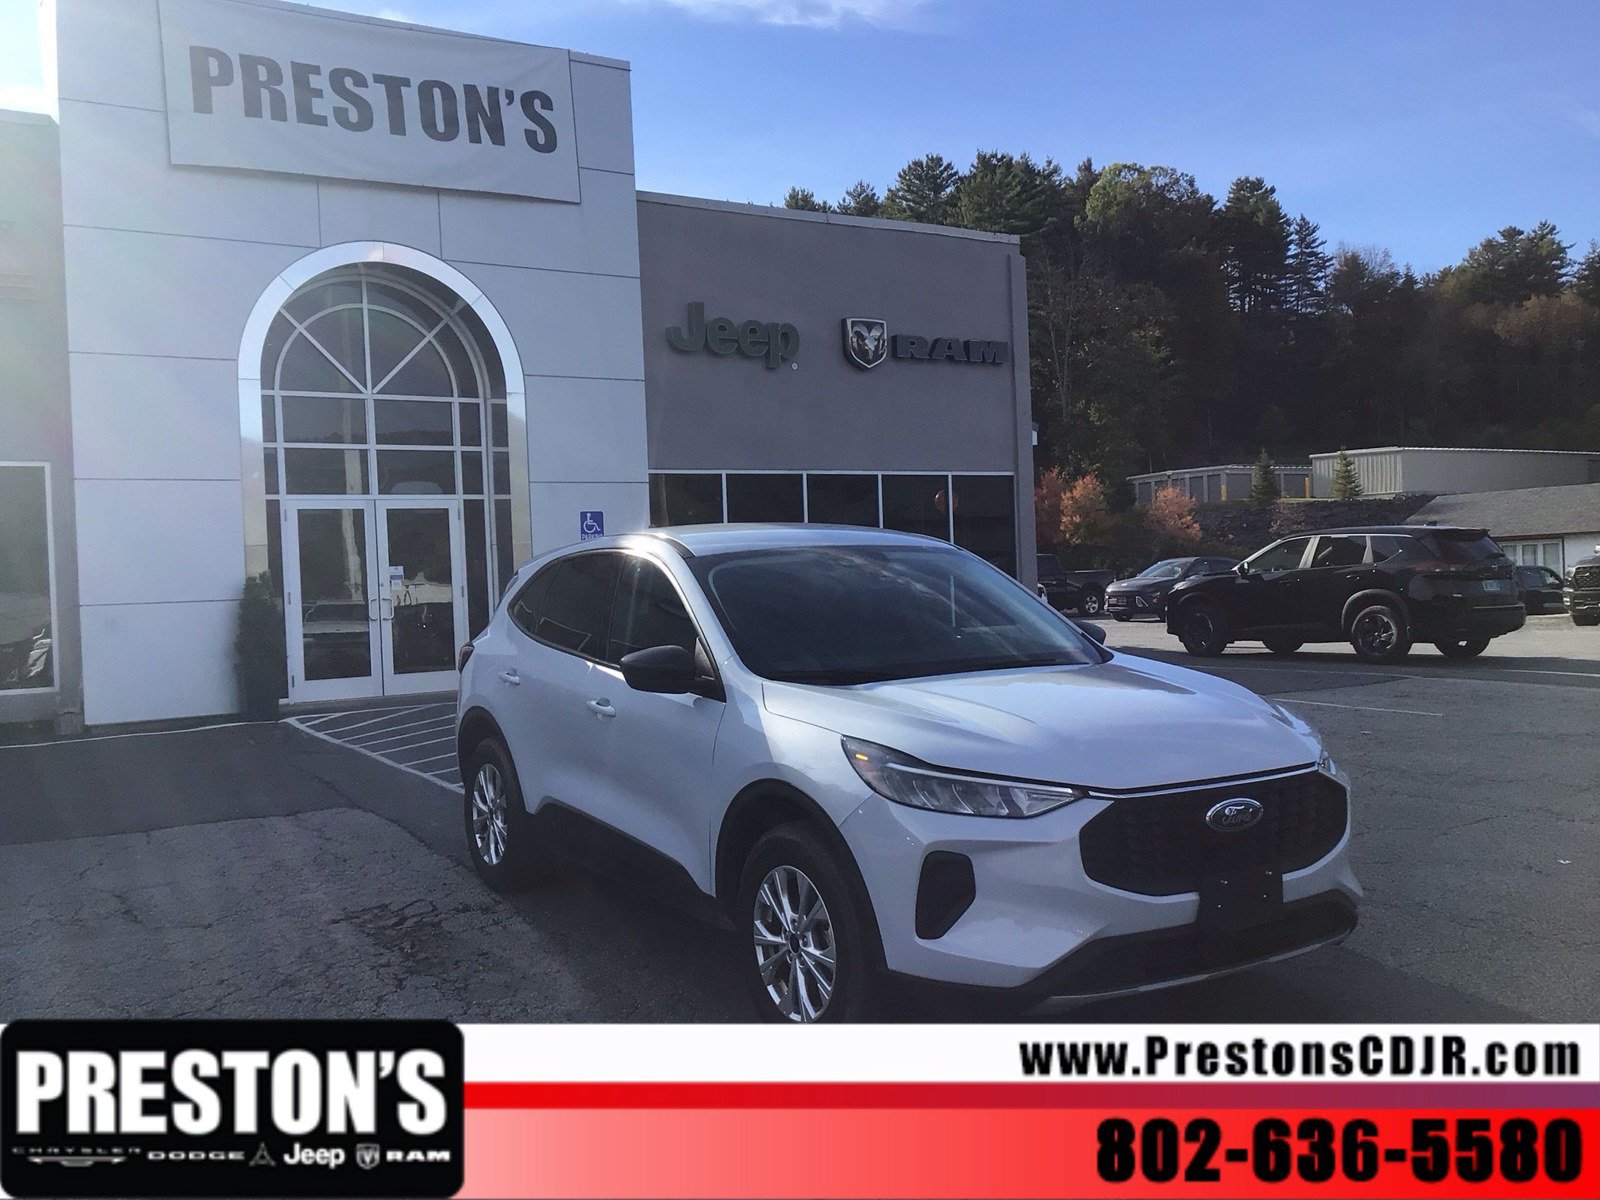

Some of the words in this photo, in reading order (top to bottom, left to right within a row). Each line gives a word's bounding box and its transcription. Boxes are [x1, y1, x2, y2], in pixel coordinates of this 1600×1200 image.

[189, 45, 558, 154] PRESTON'S
[665, 301, 800, 369] Jeep
[891, 333, 1009, 365] RAM
